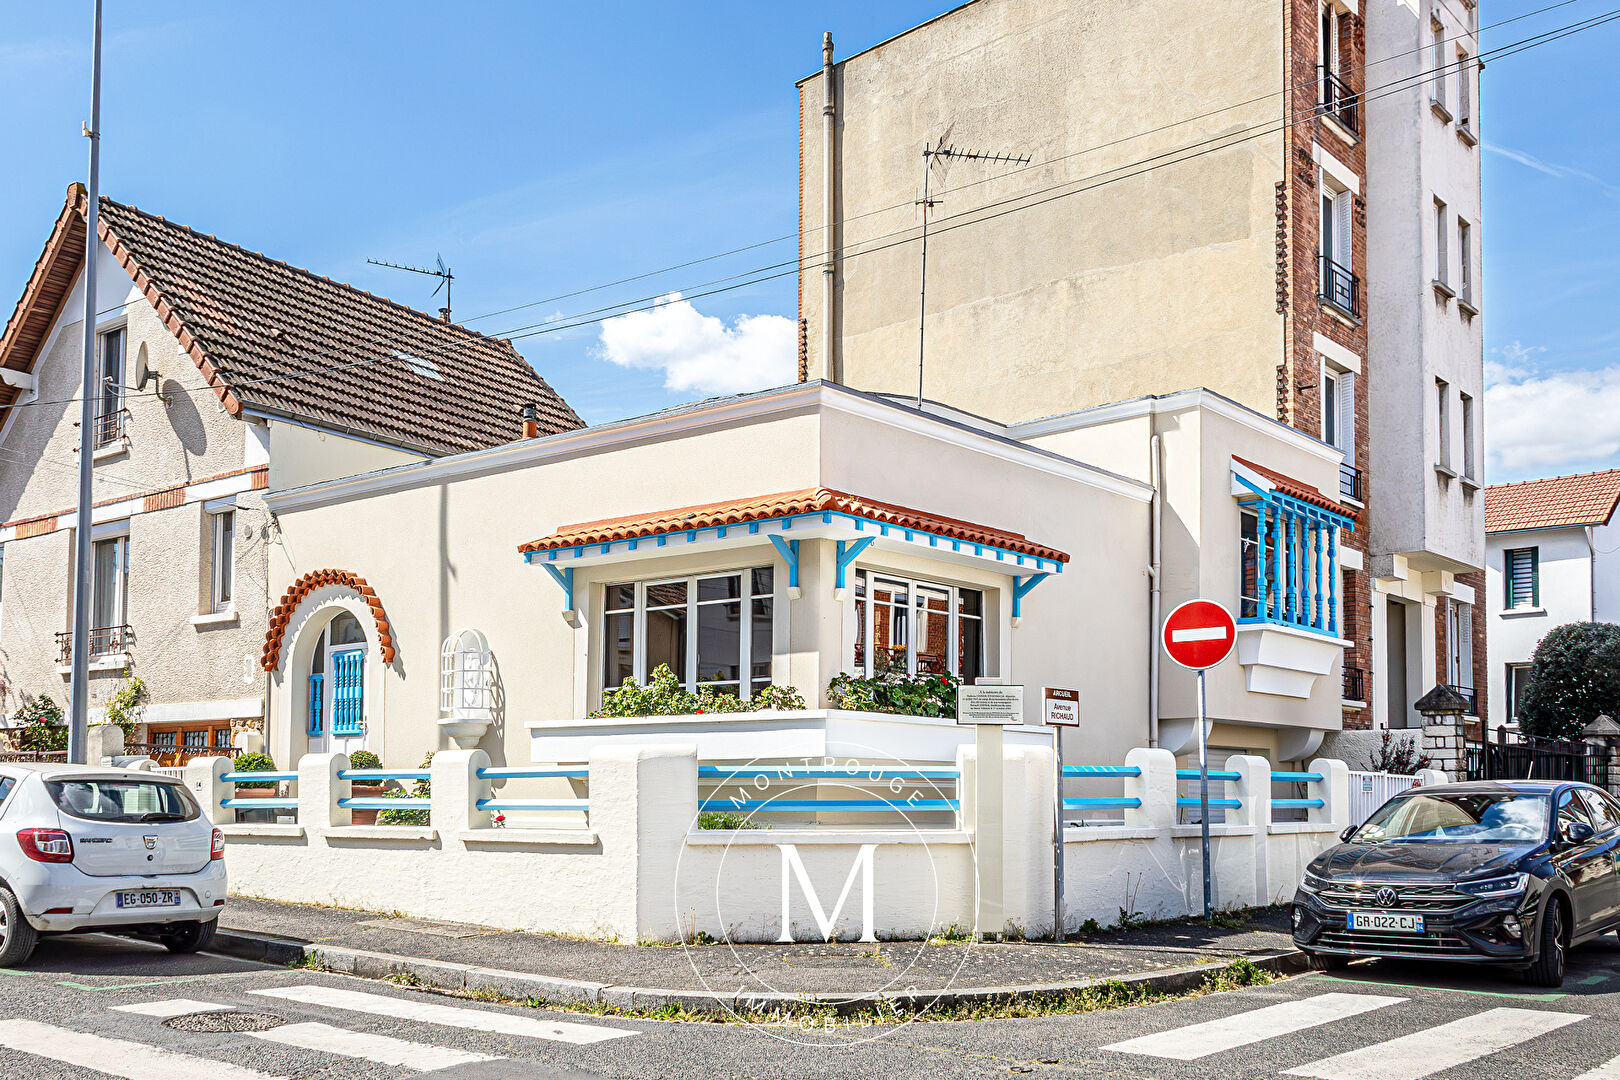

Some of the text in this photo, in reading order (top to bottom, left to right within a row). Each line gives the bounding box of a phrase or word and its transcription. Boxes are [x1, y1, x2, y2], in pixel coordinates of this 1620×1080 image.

[1053, 690, 1072, 698] ARCUEIL
[1053, 703, 1072, 711] Avenue
[1050, 712, 1074, 721] RICHAUD
[123, 891, 174, 905] EG-050-ZR
[1356, 915, 1415, 929] GR-022-CJ
